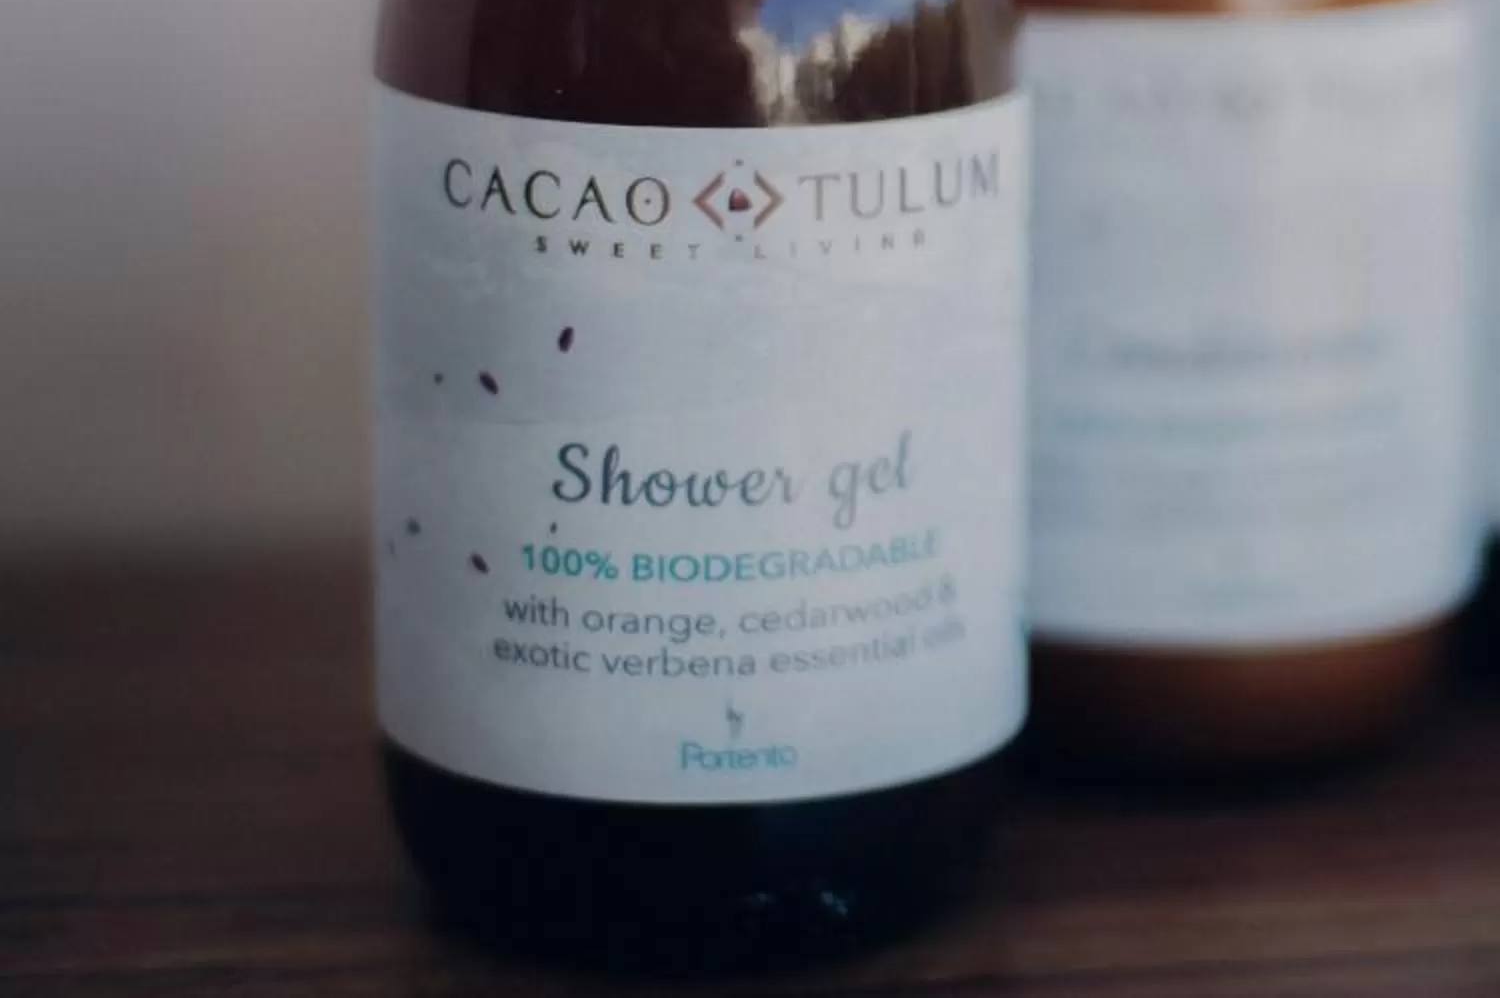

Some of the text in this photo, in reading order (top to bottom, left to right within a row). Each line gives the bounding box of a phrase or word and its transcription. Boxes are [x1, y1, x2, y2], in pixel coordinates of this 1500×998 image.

[443, 152, 999, 227] CACAO TULUM
[533, 234, 701, 261] SWEET
[551, 428, 914, 531] Shower gel
[521, 528, 942, 583] 100% BIODEGRADABLE
[503, 594, 570, 629] with
[581, 608, 725, 644] orange,
[493, 636, 593, 673] exotic
[600, 646, 757, 678] verbena
